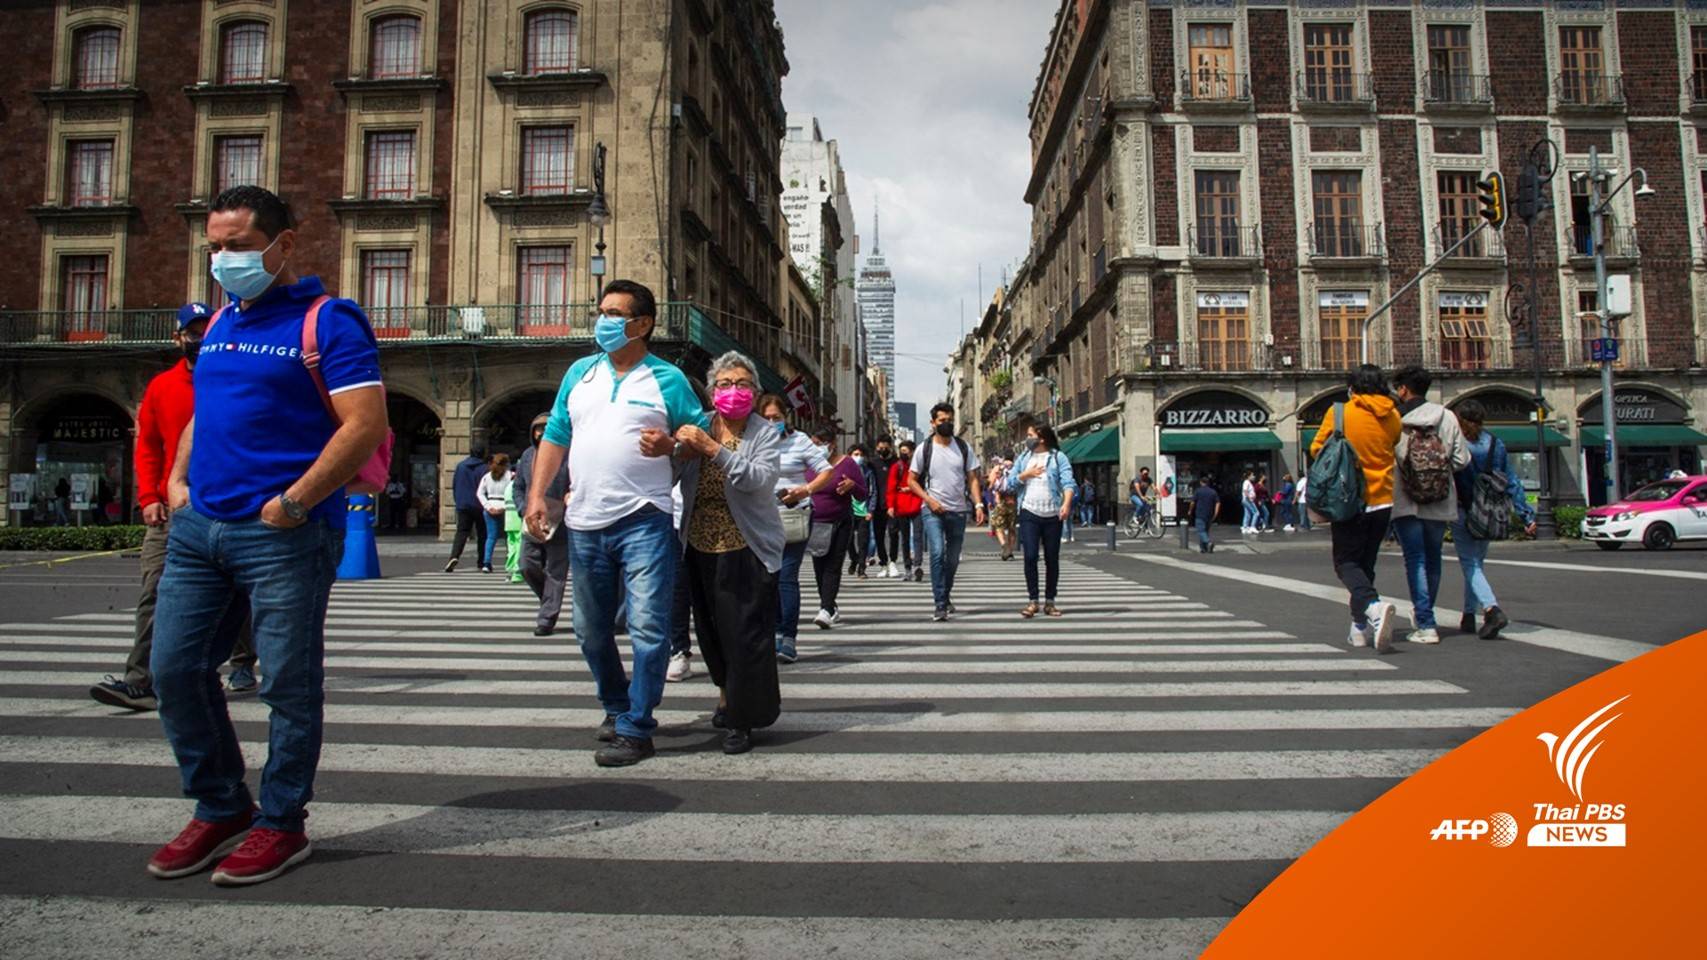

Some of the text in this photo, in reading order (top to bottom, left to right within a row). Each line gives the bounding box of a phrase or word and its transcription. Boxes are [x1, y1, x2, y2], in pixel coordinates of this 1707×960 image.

[1166, 409, 1267, 426] BIZZARRO
[1614, 407, 1656, 419] URATI
[53, 428, 121, 438] MAJESTIC
[1696, 510, 1707, 519] TA
